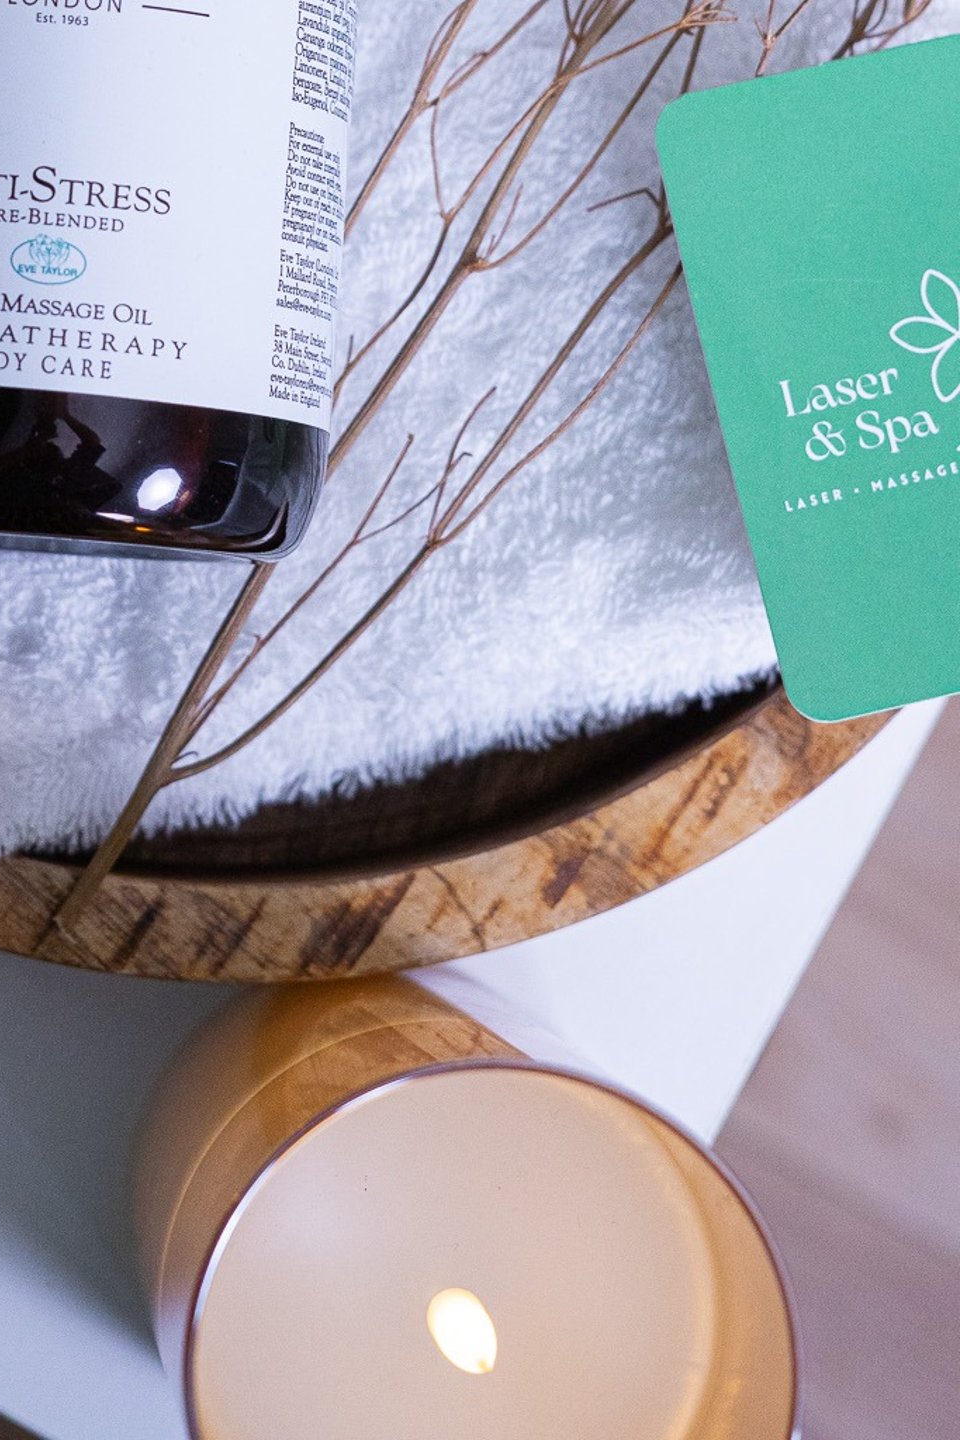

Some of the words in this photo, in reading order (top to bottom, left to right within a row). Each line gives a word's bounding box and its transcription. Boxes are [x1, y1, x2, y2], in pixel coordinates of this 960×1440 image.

[36, 12, 57, 24] Est.
[62, 14, 89, 27] 1963
[280, 248, 294, 264] Eve
[18, 264, 37, 273] EVE
[41, 265, 78, 277] TAYLOR
[0, 292, 106, 321] MASSAGE
[112, 303, 153, 325] OIL
[274, 324, 288, 339] Eve
[40, 355, 113, 379] CARE
[269, 384, 290, 400] Made
[778, 367, 899, 417] Laser
[804, 420, 847, 462] &
[854, 410, 940, 454] Spa
[784, 488, 843, 512] LASER
[870, 461, 959, 493] MASSAGE
